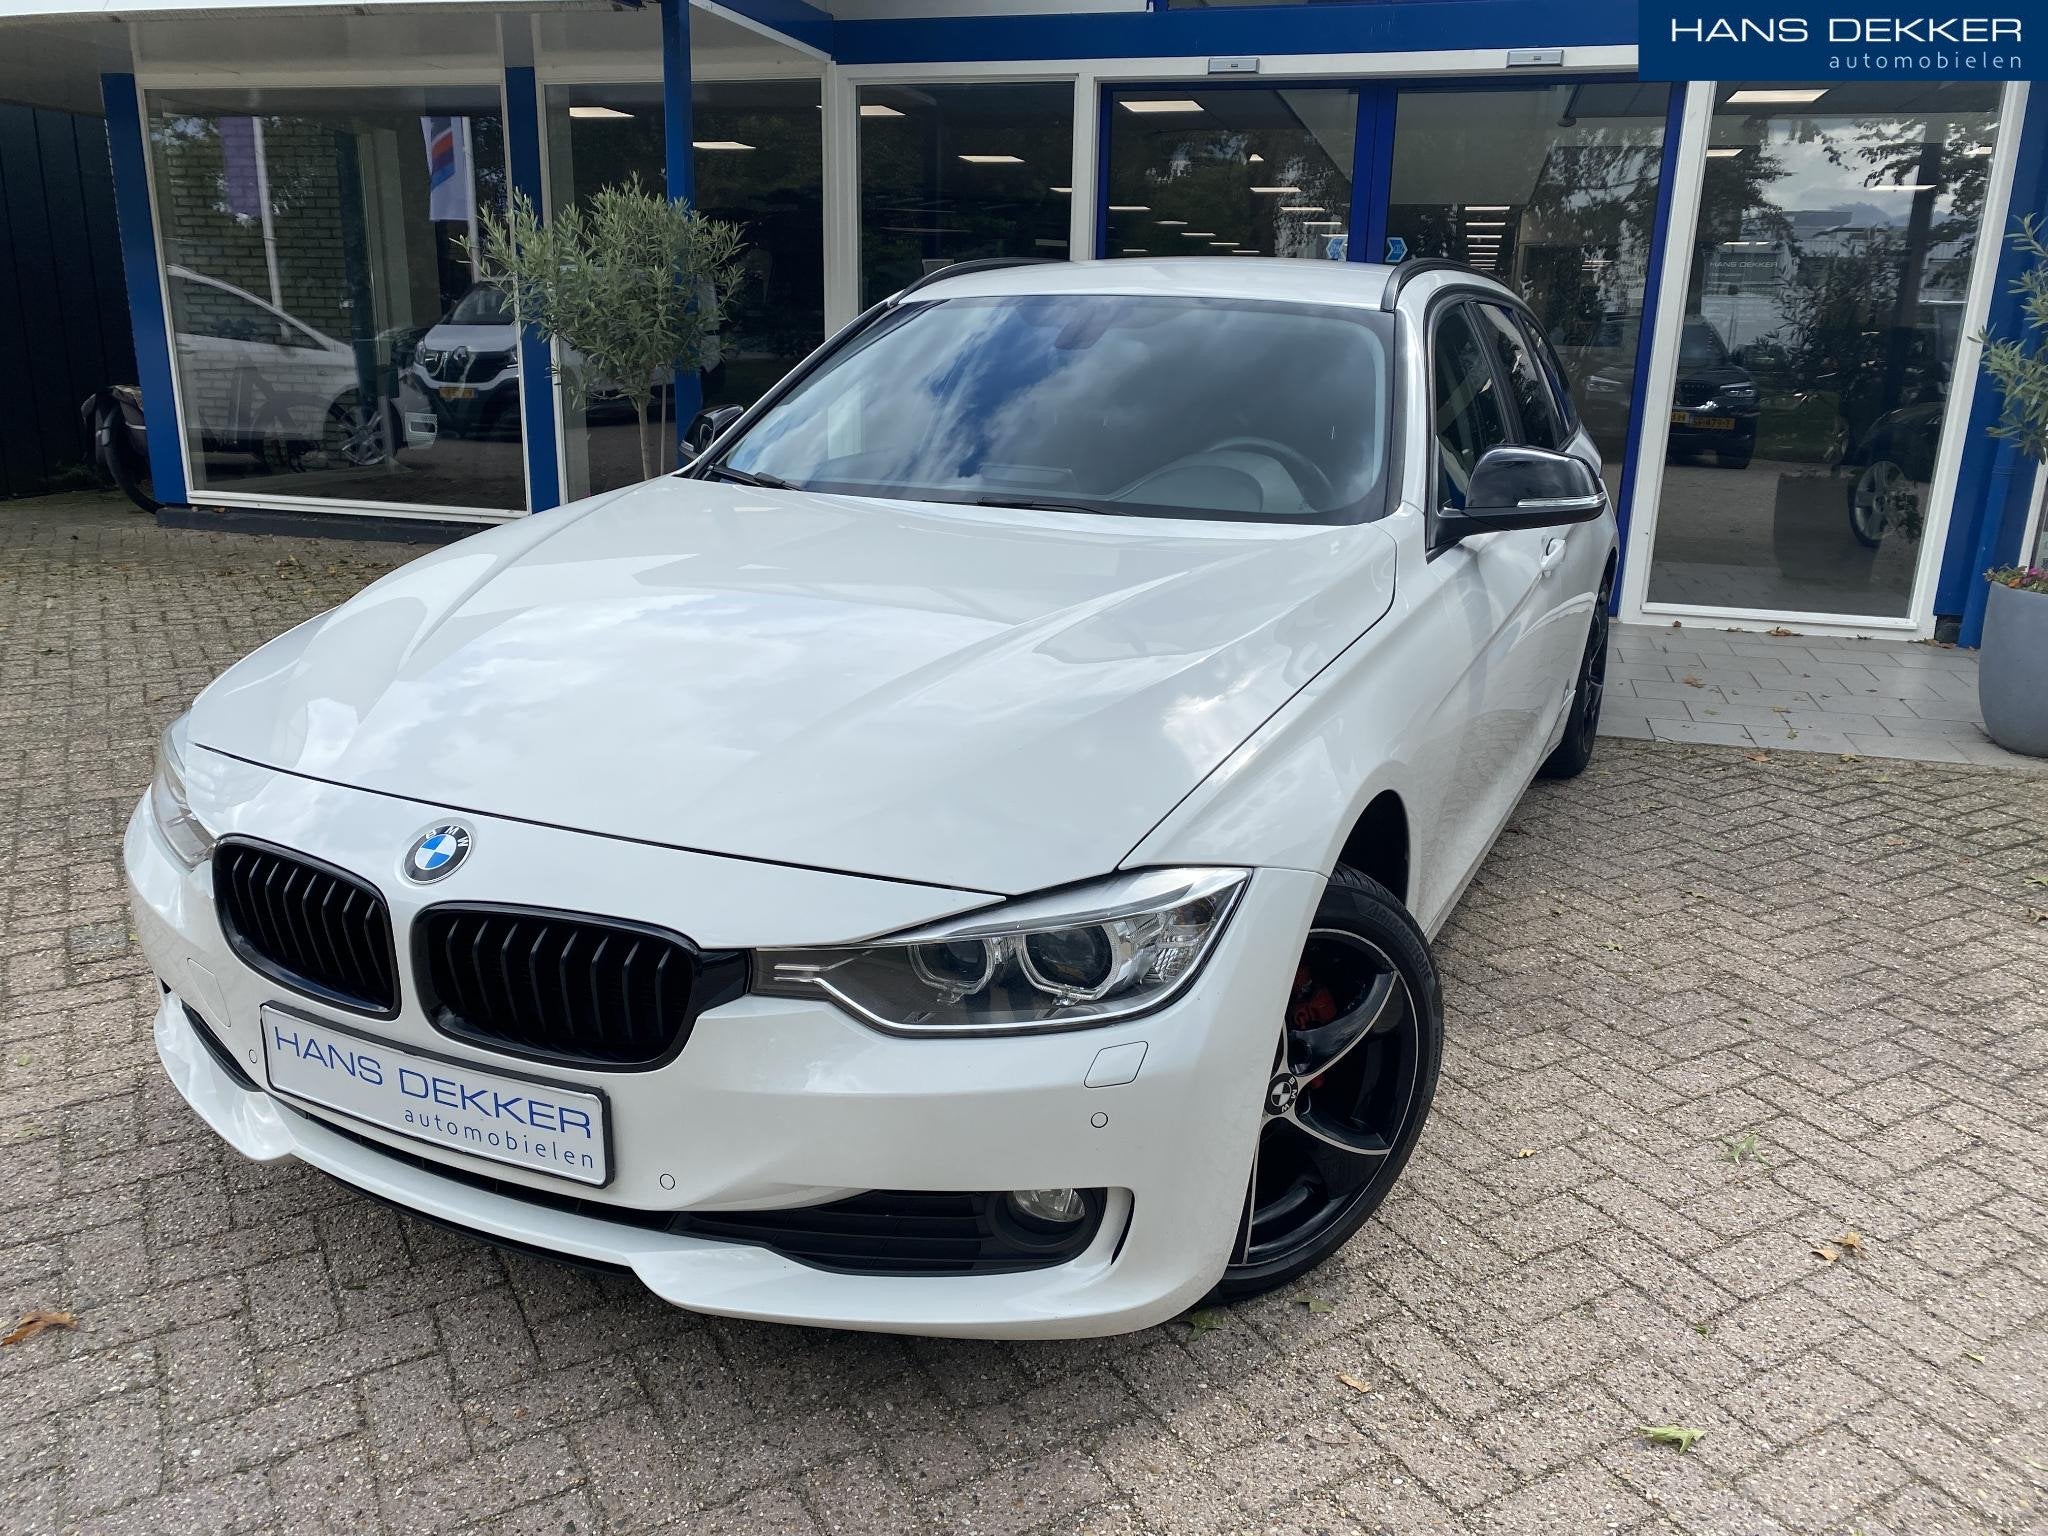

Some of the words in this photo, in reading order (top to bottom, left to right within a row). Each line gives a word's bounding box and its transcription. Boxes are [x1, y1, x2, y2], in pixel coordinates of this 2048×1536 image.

[425, 825, 469, 847] BMW
[274, 1026, 383, 1086] HANS
[398, 1068, 592, 1139] DEKKER
[1281, 1076, 1297, 1113] BMW
[404, 1109, 594, 1169] automobielen
